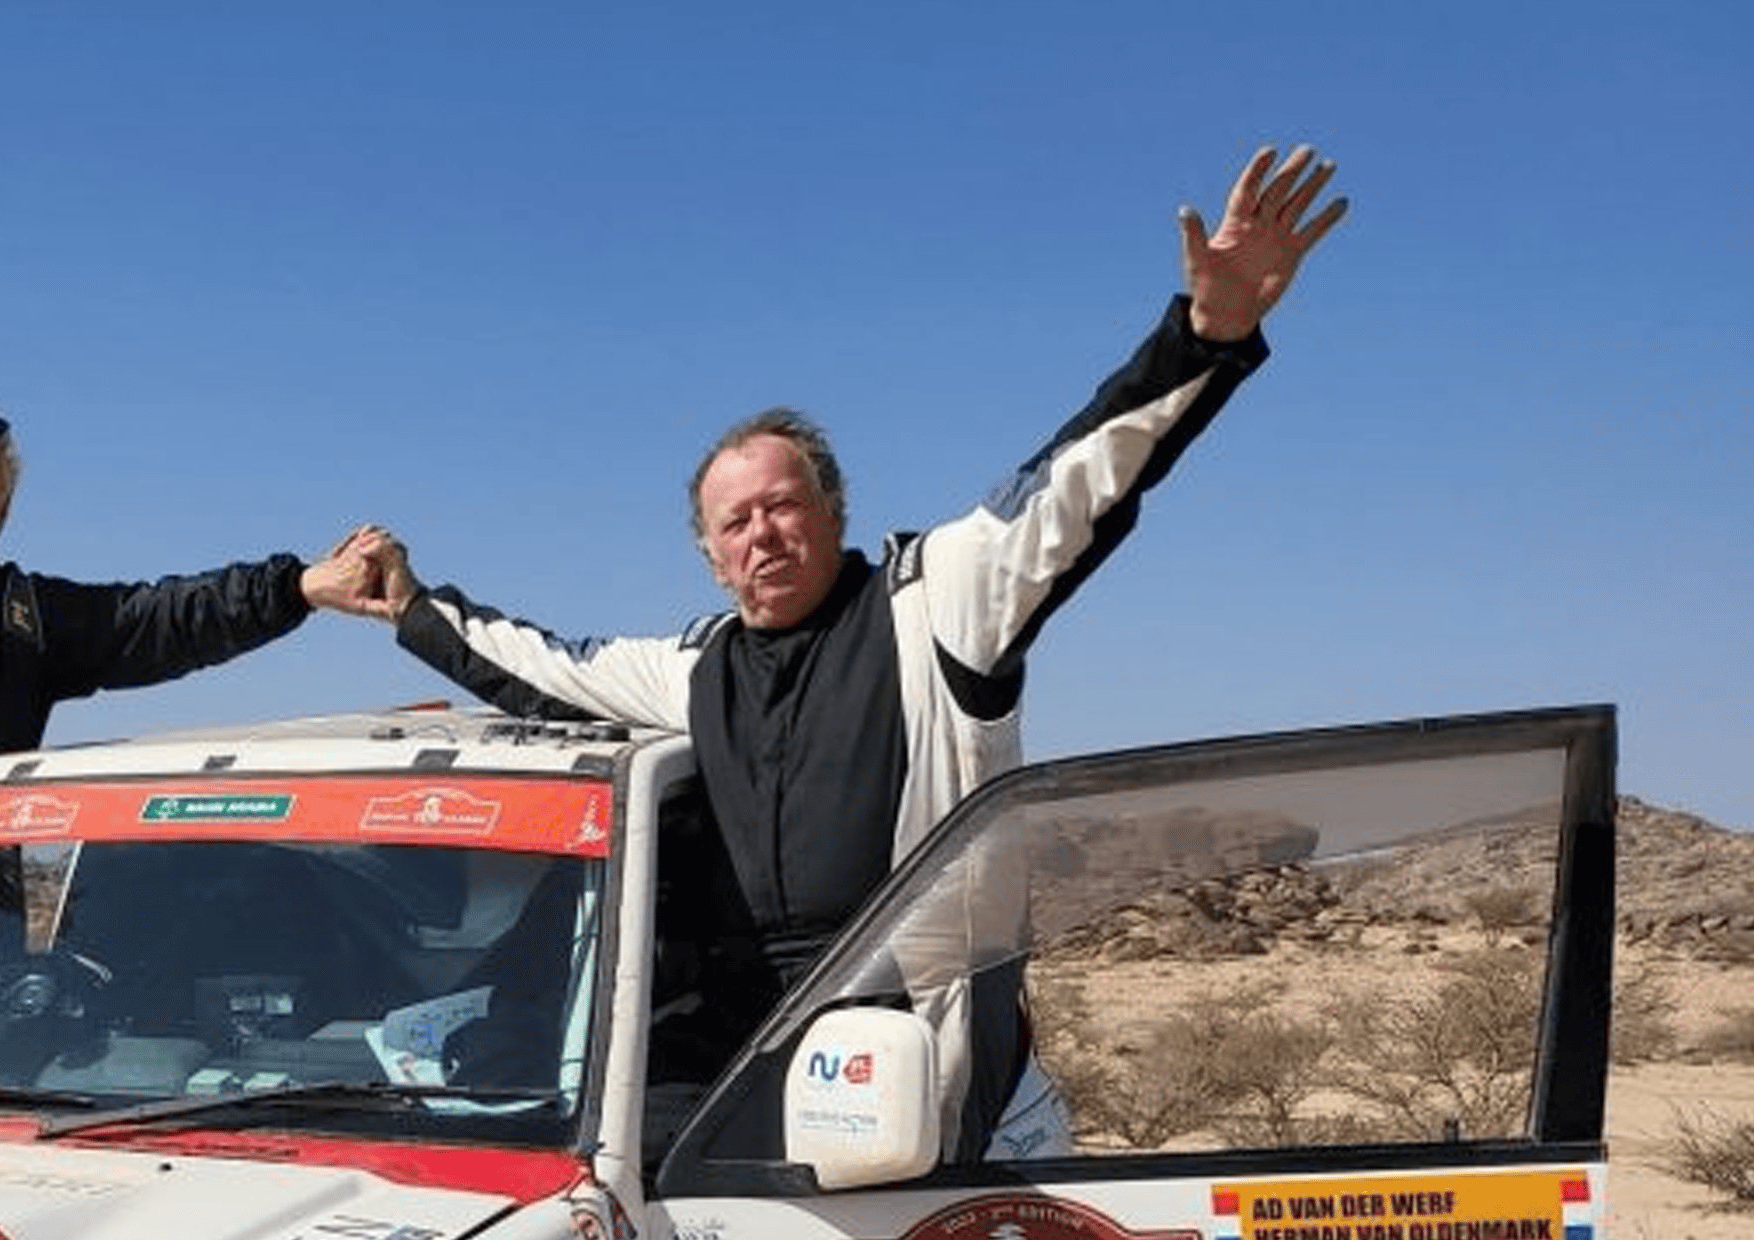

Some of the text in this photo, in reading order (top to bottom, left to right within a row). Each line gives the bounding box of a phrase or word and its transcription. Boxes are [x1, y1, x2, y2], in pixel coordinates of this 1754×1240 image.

[1253, 1191, 1456, 1221] AD VAN DER WERF
